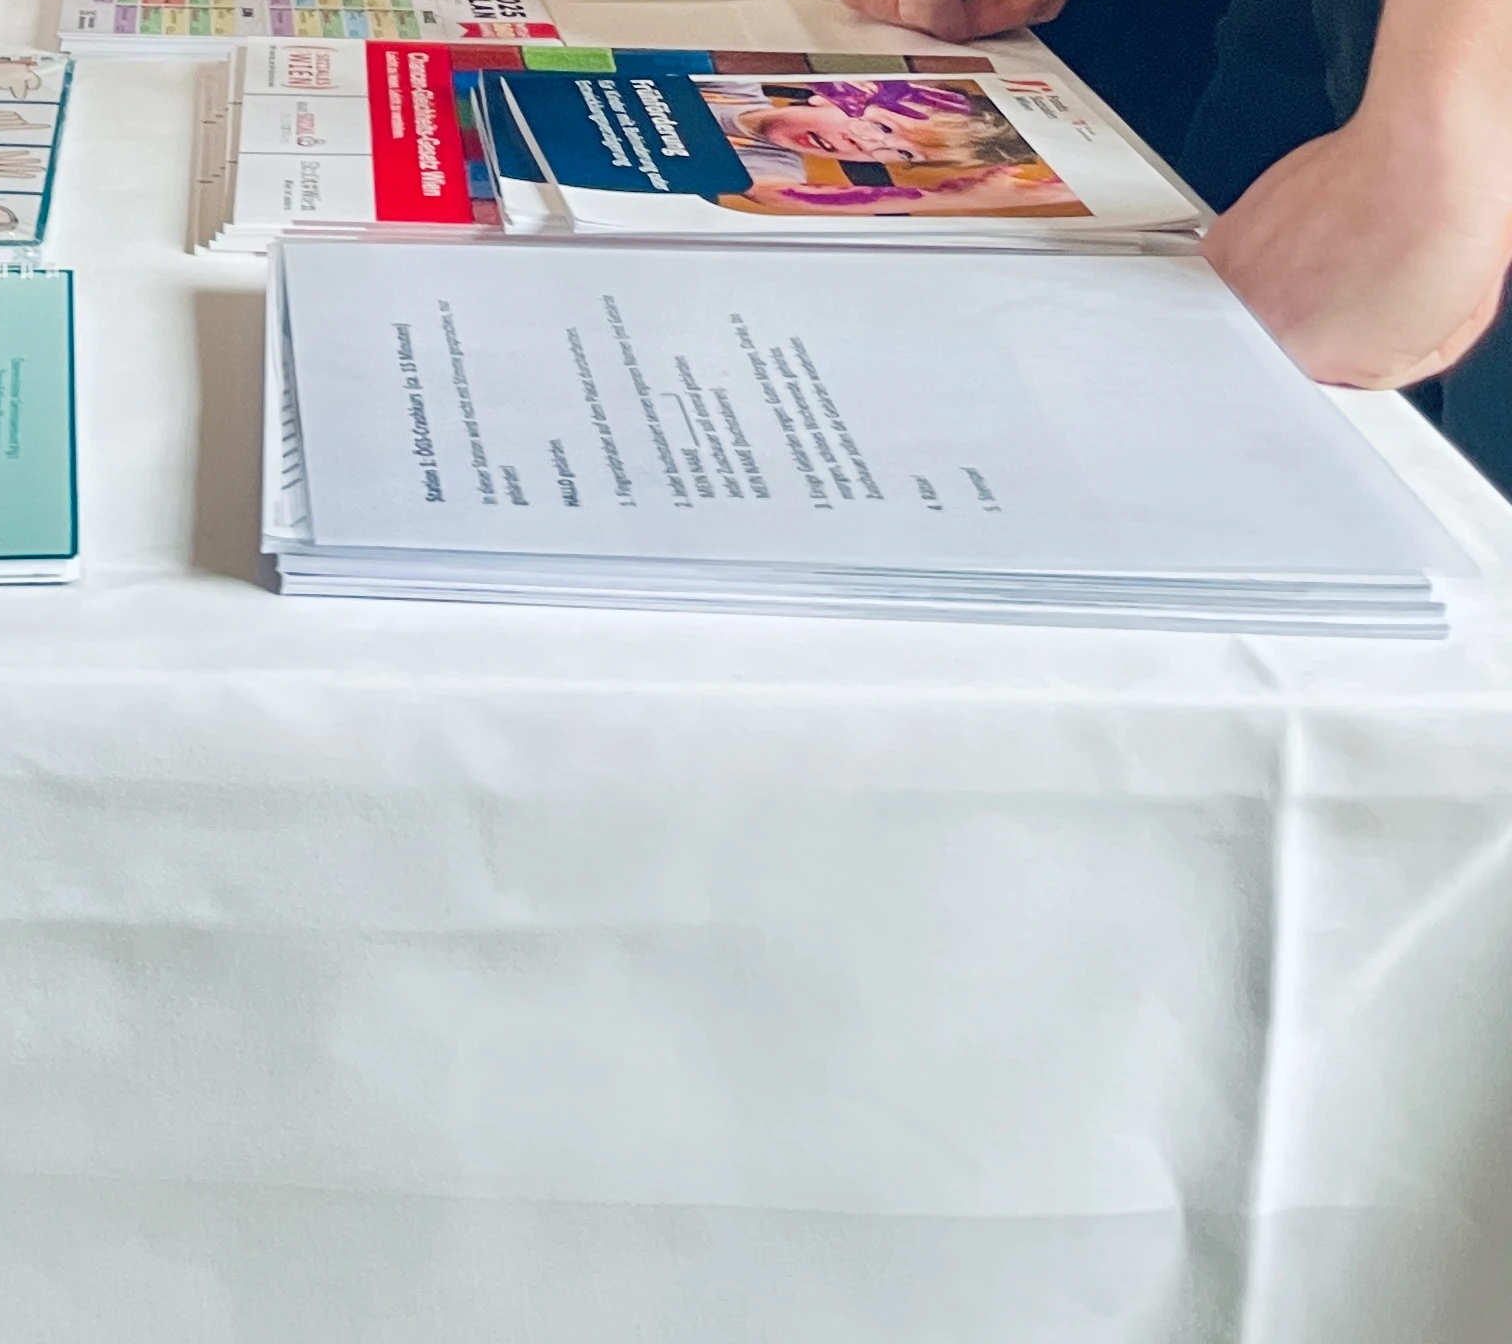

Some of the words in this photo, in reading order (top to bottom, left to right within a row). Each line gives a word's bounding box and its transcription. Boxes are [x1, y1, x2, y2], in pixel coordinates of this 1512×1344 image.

[288, 54, 313, 85] WIEN
[630, 79, 690, 156] Frühförderung
[421, 171, 445, 196] Wien
[407, 393, 435, 457] ÖGS-Crashkurs
[425, 469, 445, 502] Station
[557, 479, 580, 507] HALLO
